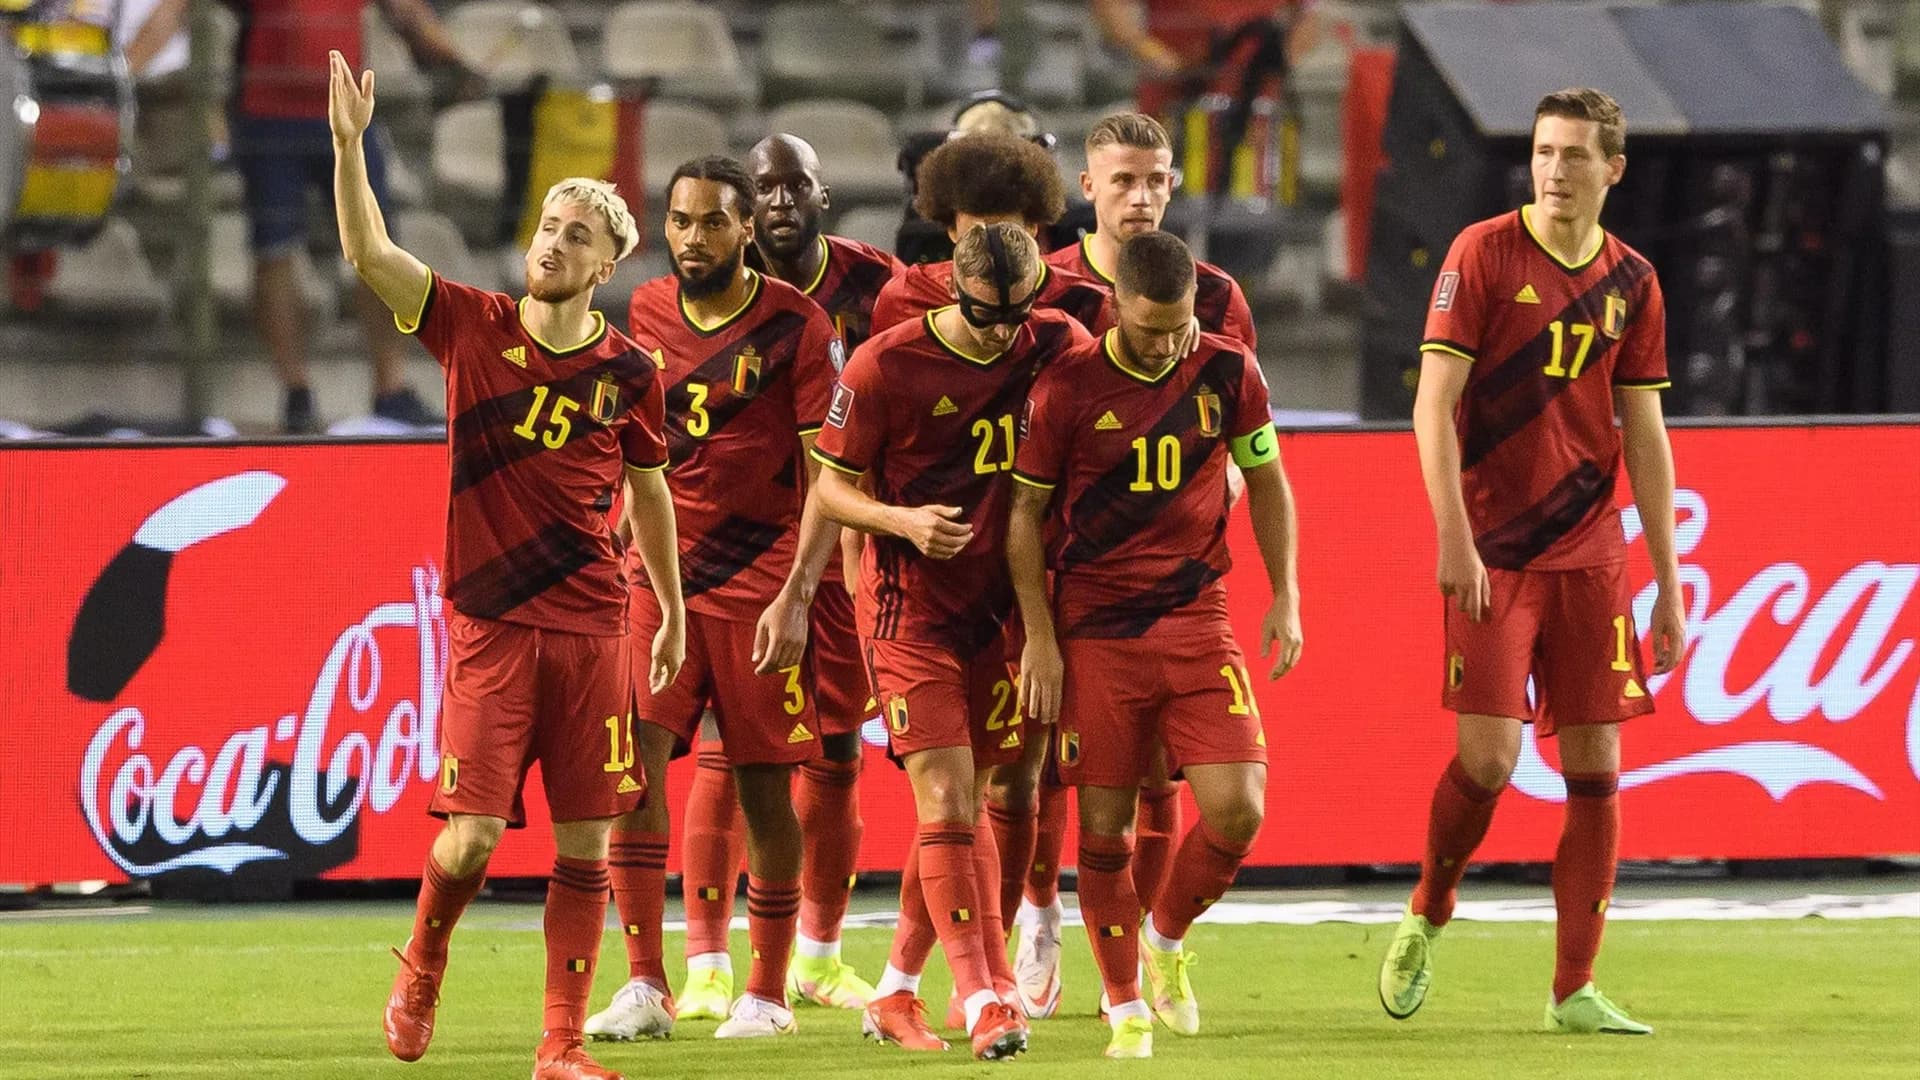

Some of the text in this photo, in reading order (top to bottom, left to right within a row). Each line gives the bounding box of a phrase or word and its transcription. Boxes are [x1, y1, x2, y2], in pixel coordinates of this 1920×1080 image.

[1543, 320, 1595, 379] 17
[513, 385, 581, 449] 15
[686, 382, 710, 437] 3
[971, 413, 1015, 475] 21
[1129, 434, 1181, 492] 10
[1250, 431, 1269, 457] C
[1611, 615, 1633, 672] 1
[79, 557, 449, 877] Coca-Col
[778, 664, 805, 715] 3
